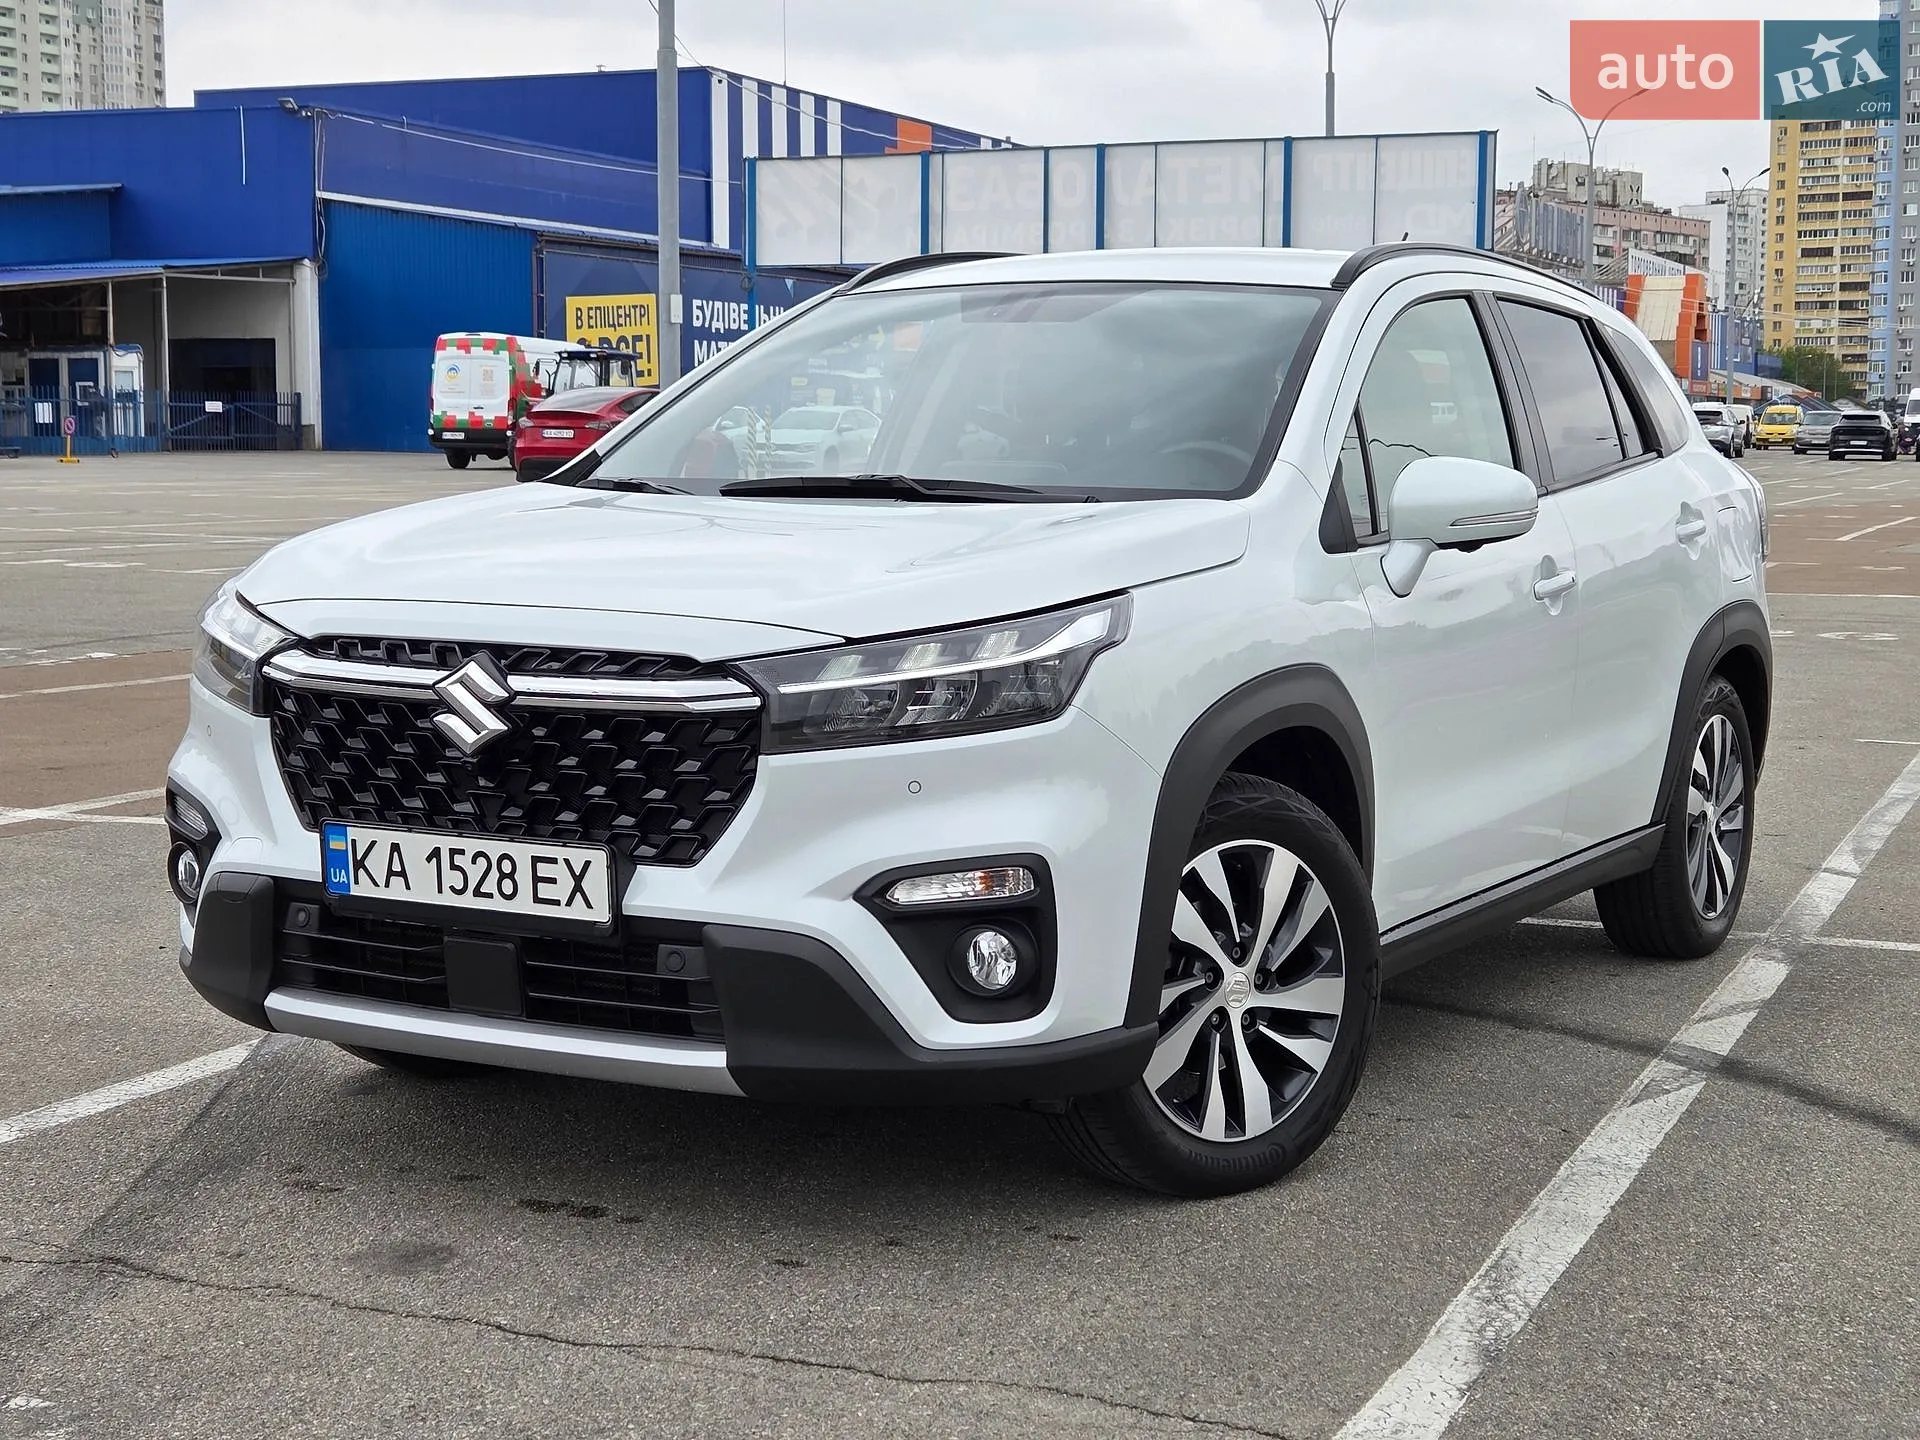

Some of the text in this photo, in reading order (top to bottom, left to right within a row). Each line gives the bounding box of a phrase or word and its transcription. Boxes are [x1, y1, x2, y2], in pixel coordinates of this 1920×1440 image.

[575, 304, 650, 332] В ЕПІЦЕНТРІ
[331, 867, 348, 884] UA
[350, 838, 594, 910] KA 1528 EX
